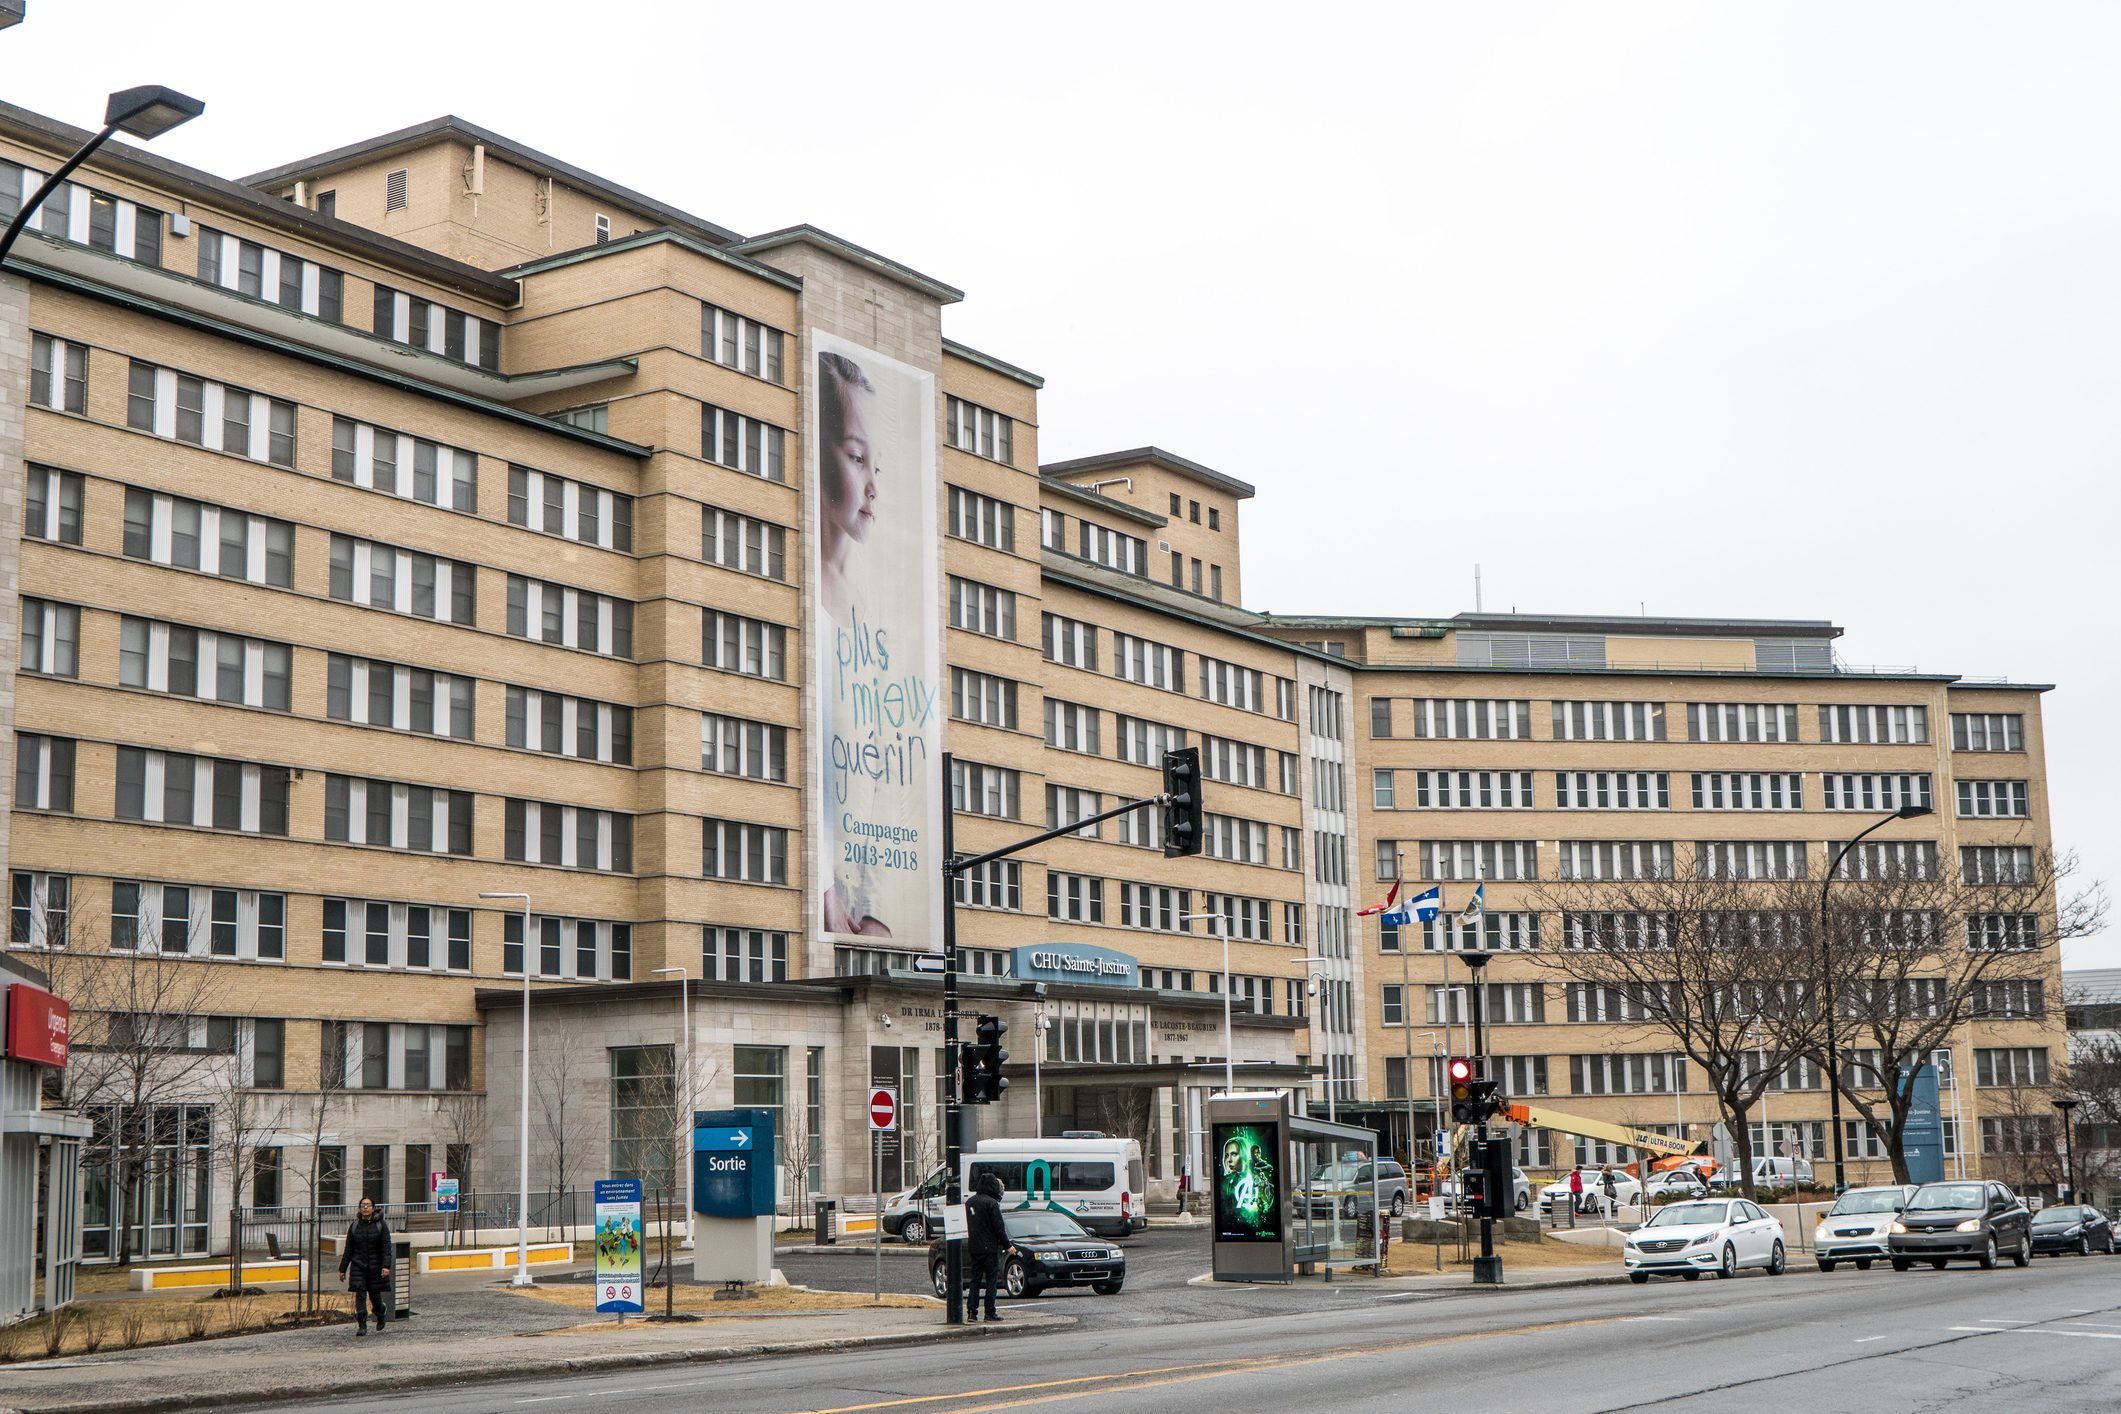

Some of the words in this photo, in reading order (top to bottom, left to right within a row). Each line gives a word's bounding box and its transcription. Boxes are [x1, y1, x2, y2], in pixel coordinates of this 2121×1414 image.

[836, 605, 889, 700] plus
[852, 675, 937, 736] mieux
[832, 732, 926, 804] guérin
[842, 812, 918, 843] Campagne
[844, 842, 918, 871] 2013-2018
[1032, 951, 1061, 969] CHU
[1063, 954, 1130, 976] Sainte-Justine
[901, 1007, 912, 1017] DR
[915, 1007, 935, 1018] IRMA
[1636, 1134, 1648, 1143] JLG
[1650, 1137, 1667, 1148] ULTRA
[1668, 1141, 1686, 1151] BOOM
[709, 1156, 746, 1171] Sortie
